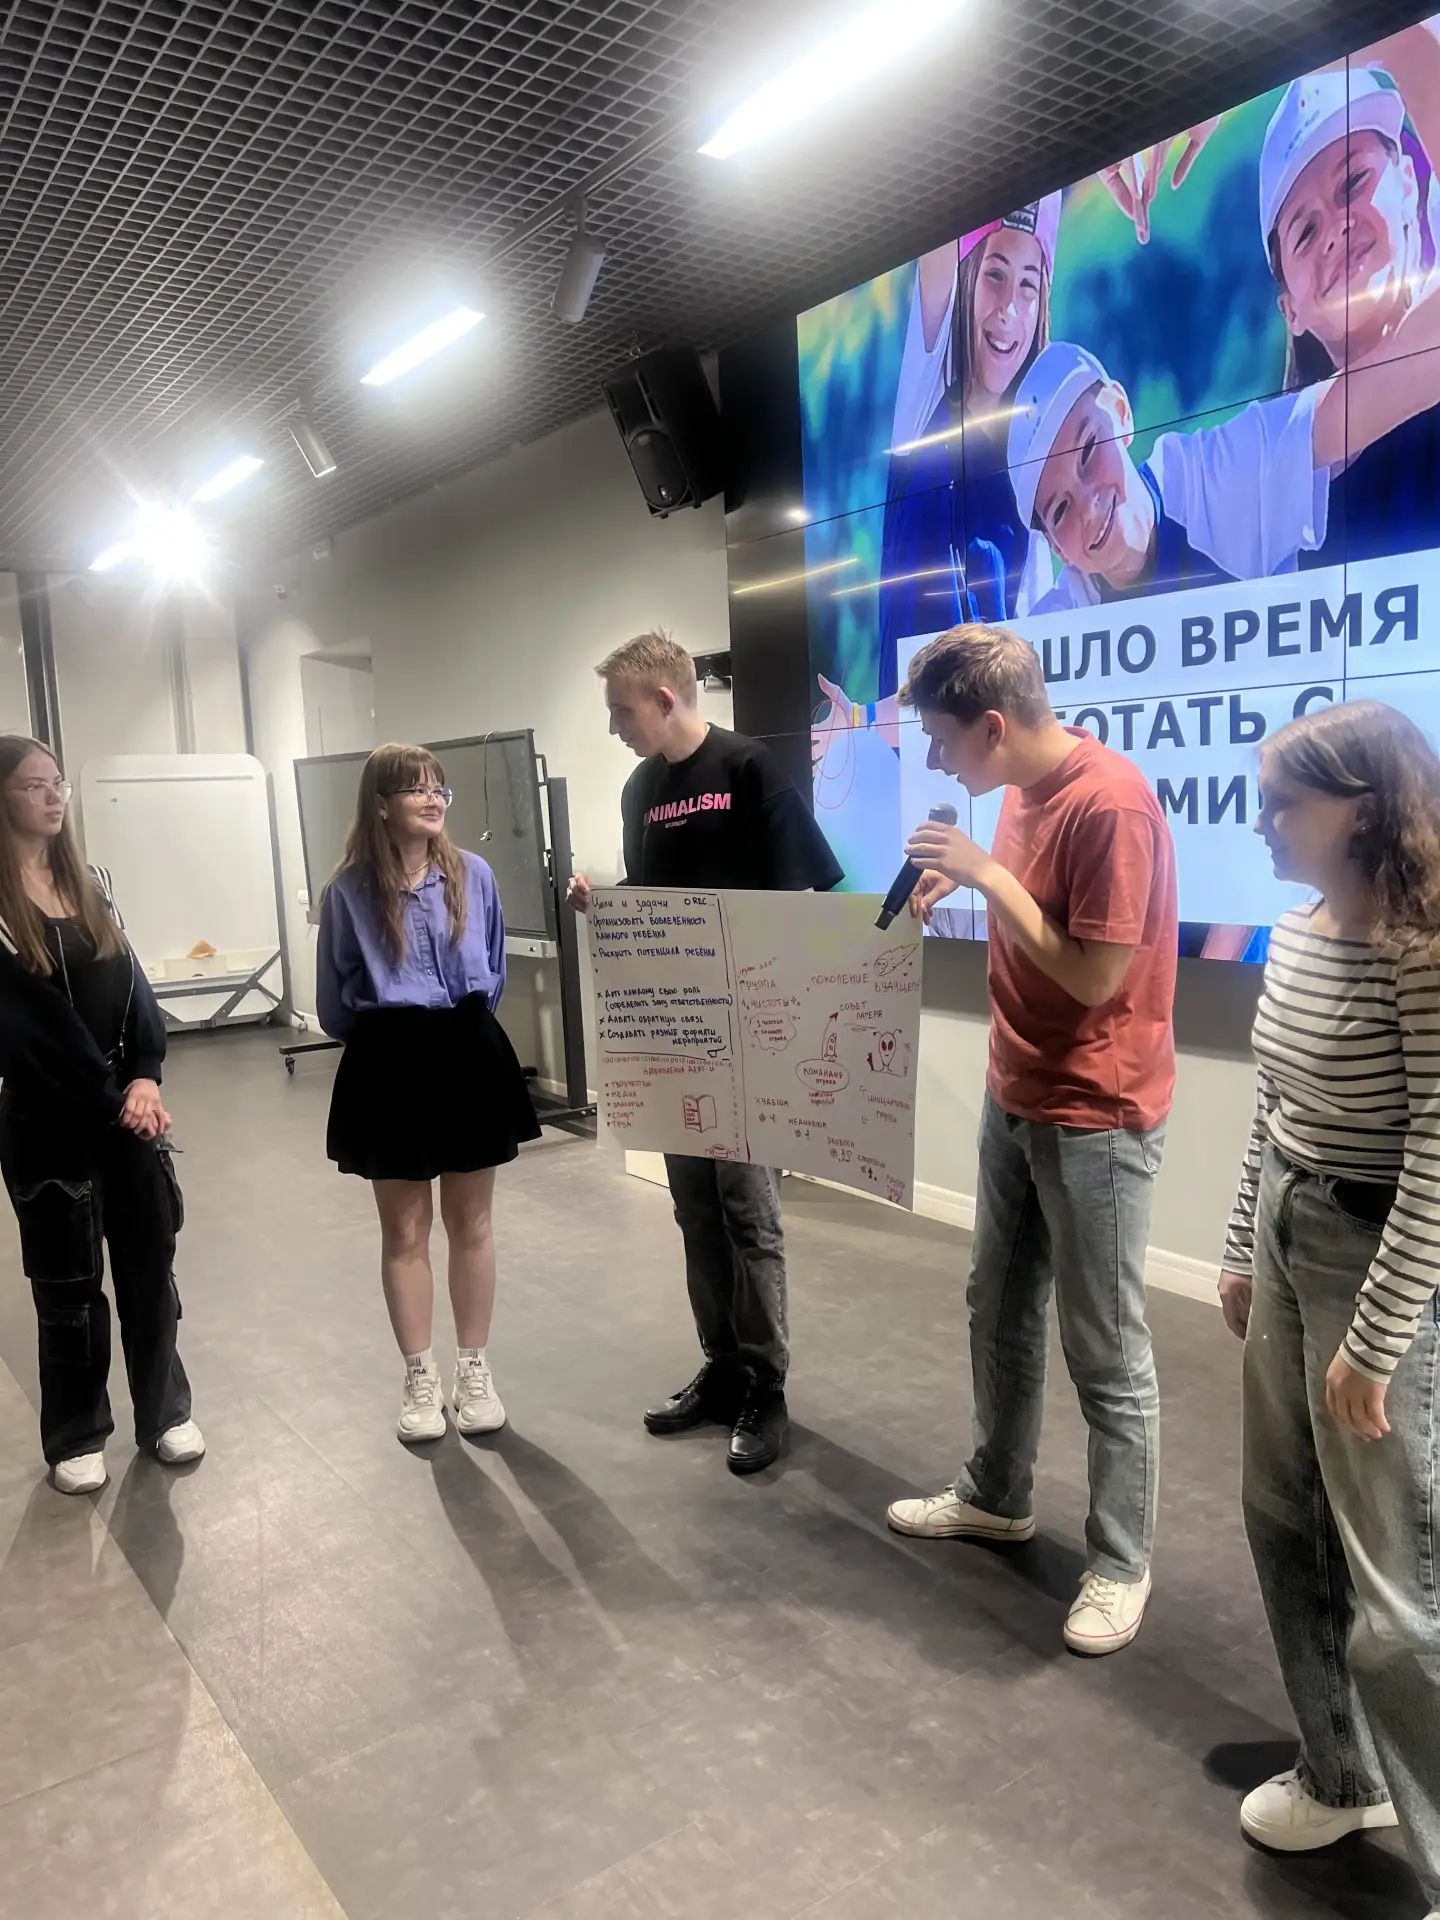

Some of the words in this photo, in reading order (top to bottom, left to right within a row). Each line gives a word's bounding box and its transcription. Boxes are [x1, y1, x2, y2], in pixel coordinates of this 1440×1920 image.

[1042, 624, 1157, 684] ШЛО
[1181, 584, 1420, 668] ВРЕМЯ
[1054, 694, 1267, 751] ОТАТЬ
